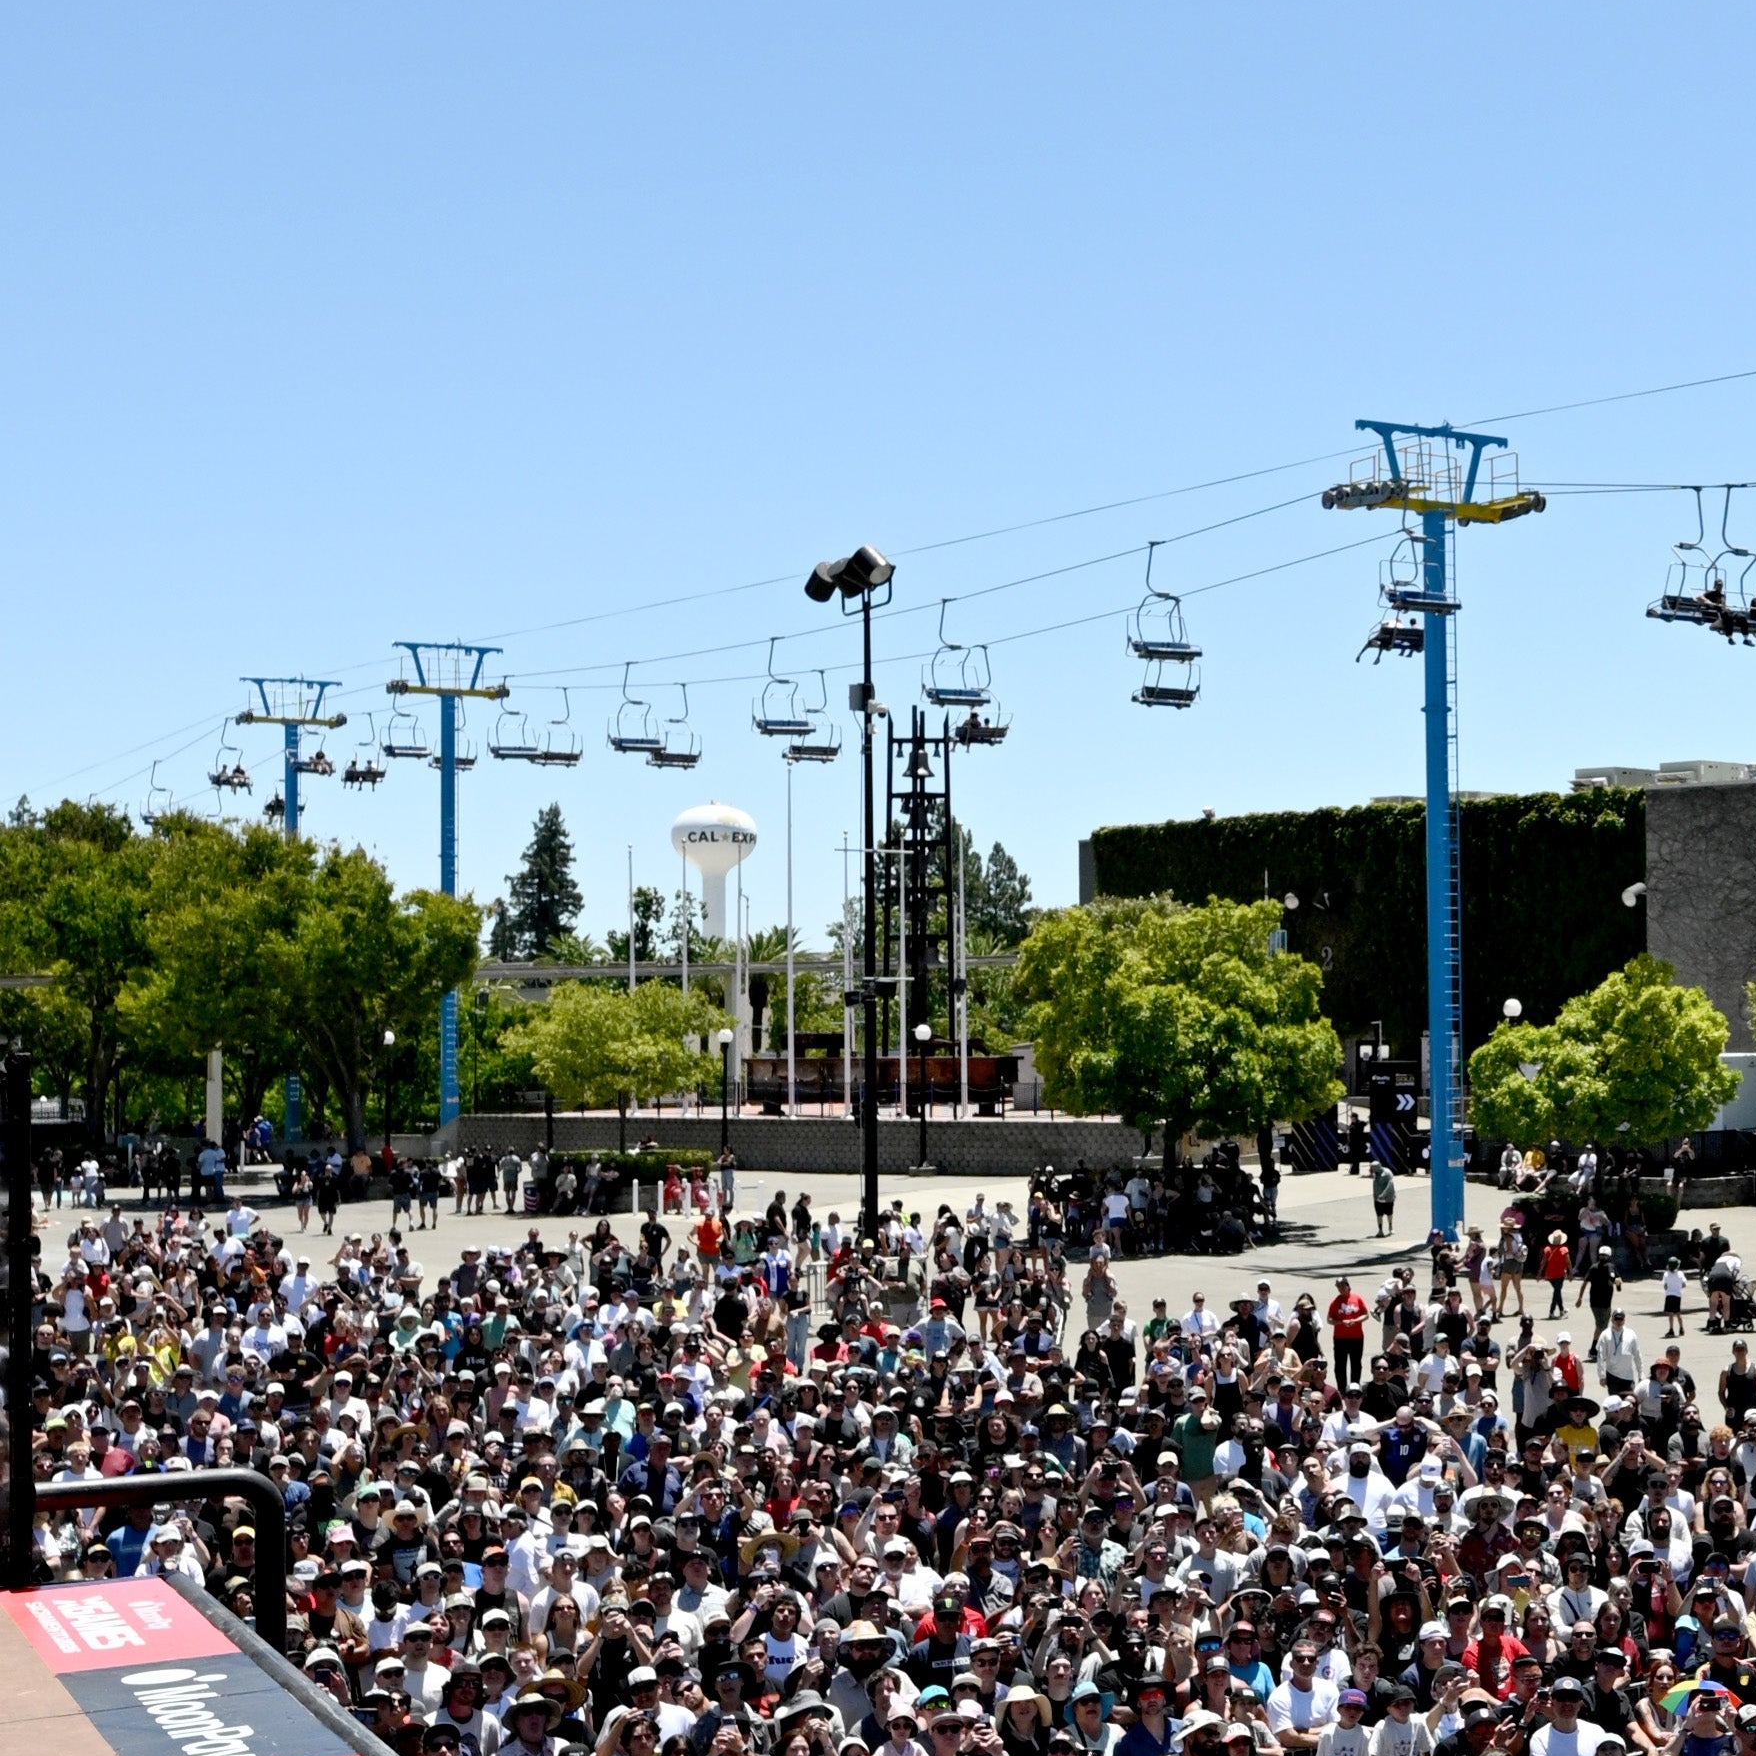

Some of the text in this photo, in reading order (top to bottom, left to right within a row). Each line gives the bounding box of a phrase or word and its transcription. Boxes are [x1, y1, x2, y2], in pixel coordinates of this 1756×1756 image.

[687, 831, 720, 843] CAL
[1321, 946, 1334, 971] 2
[1399, 1445, 1410, 1456] 10
